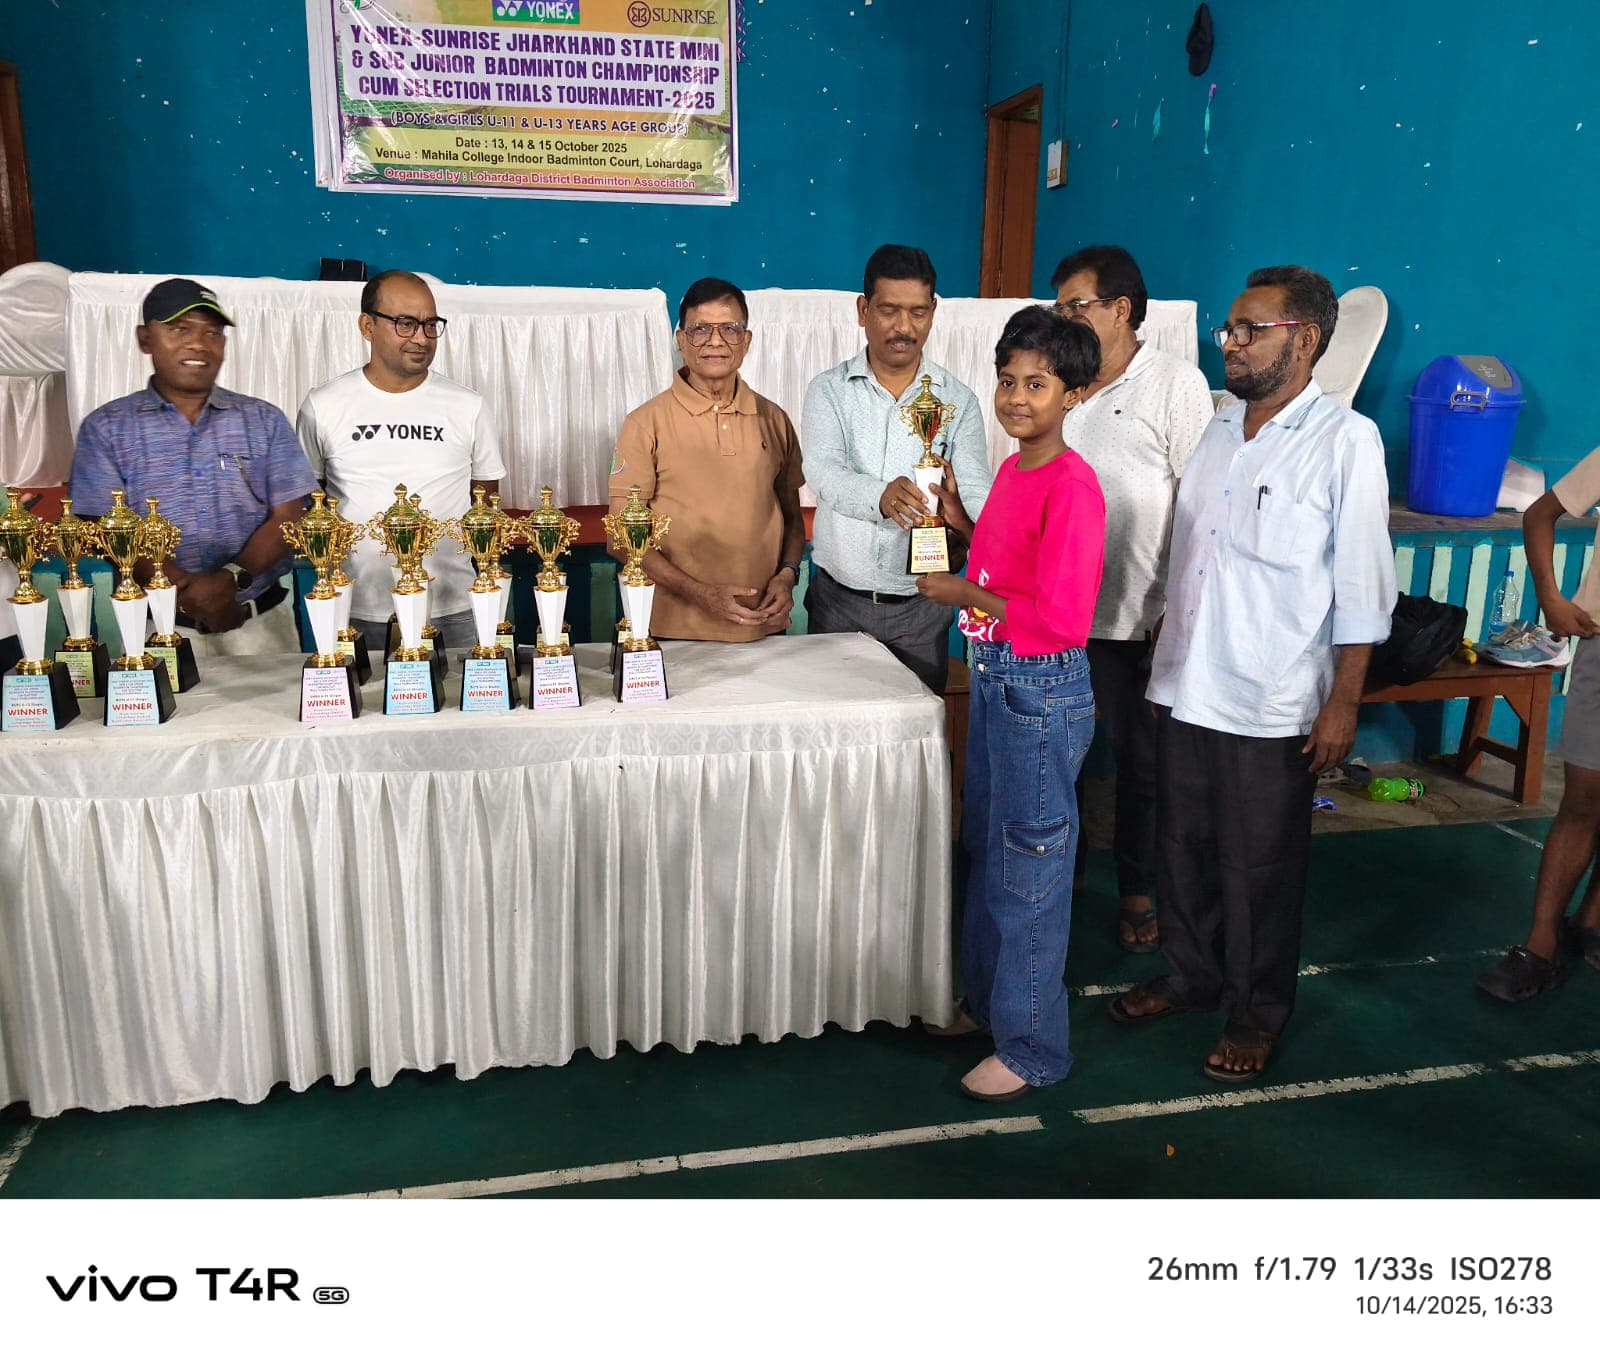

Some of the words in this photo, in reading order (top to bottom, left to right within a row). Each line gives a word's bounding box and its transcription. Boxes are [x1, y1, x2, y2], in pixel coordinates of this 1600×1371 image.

[527, 1, 574, 19] YONEX
[506, 32, 616, 57] JHARKHAND
[620, 38, 675, 60] STATE
[680, 41, 720, 62] MINI
[352, 50, 363, 69] &
[410, 53, 475, 74] JUNIOR
[485, 56, 588, 79] BADMINTON
[592, 61, 720, 85] CHAMPIONSHIP
[359, 76, 399, 96] CUM
[403, 78, 491, 100] SELECTION
[495, 82, 552, 104] TRIALS
[391, 110, 430, 126] (BOYS
[434, 112, 446, 125] &
[447, 112, 484, 127] GIRLS
[487, 114, 515, 128] U-11
[521, 118, 530, 129] &
[533, 117, 563, 130] U-13
[567, 118, 607, 132] YEARS
[611, 120, 636, 133] AGE
[456, 136, 481, 149] Date
[491, 138, 508, 151] 13,
[511, 139, 523, 150] 14
[527, 140, 536, 150] &
[539, 140, 552, 151] 15
[554, 140, 598, 152] October
[602, 142, 628, 153] 2025
[375, 147, 411, 160] Venue
[421, 148, 459, 162] Mahila
[462, 151, 504, 165] College
[507, 153, 544, 164] Indoor
[547, 154, 606, 167] Badminton
[609, 156, 643, 170] Court,
[646, 158, 703, 172] Lohardaga
[384, 167, 443, 181] Organised
[446, 168, 460, 183] by
[470, 170, 528, 184] Lohardaga
[531, 173, 570, 185] District
[573, 175, 631, 187] Badminton
[634, 177, 696, 189] Association
[386, 424, 444, 442] YONEX
[537, 686, 573, 696] WINNER
[626, 680, 660, 689] WINNER
[306, 699, 346, 707] WINNER
[390, 692, 429, 700] WINNER
[8, 708, 48, 716] WINNER
[112, 702, 153, 711] WINNER
